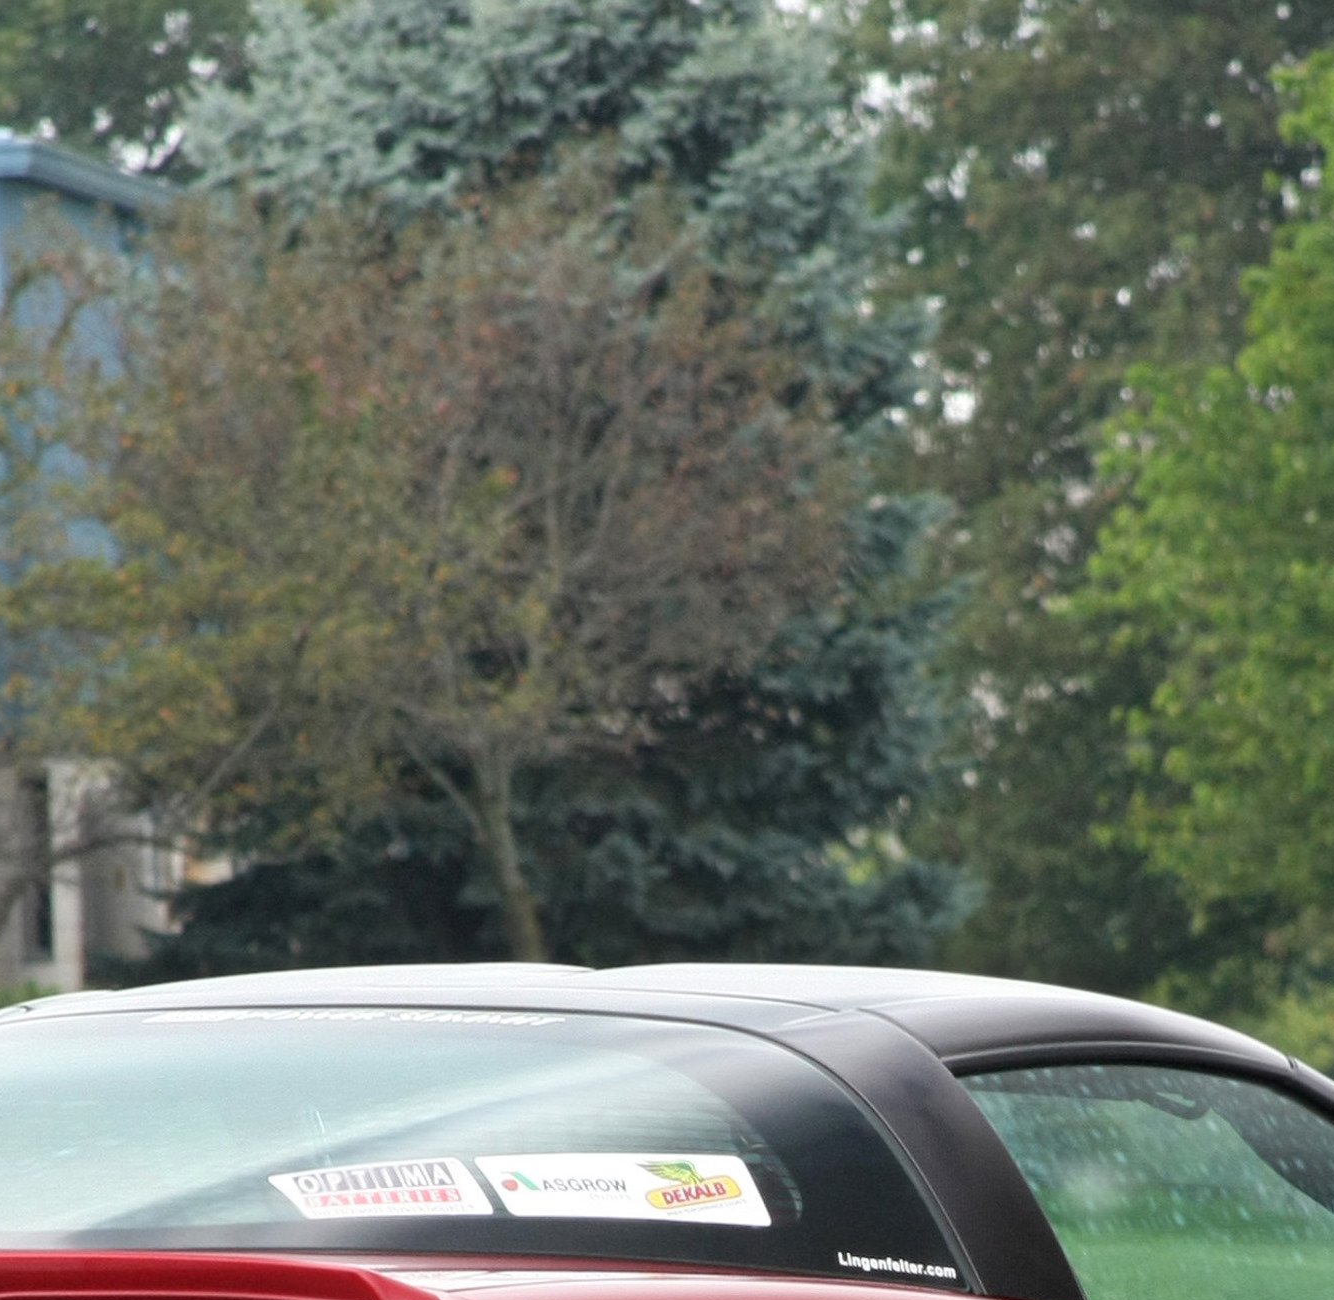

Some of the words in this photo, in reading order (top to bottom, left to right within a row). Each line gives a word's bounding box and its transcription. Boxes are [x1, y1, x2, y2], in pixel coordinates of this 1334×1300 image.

[293, 1162, 454, 1194] OPTIMA
[543, 1178, 627, 1192] ASGROW
[304, 1188, 461, 1208] BATTERIES
[662, 1182, 727, 1205] DEKALB
[837, 1251, 957, 1279] Lingenfelter.com
